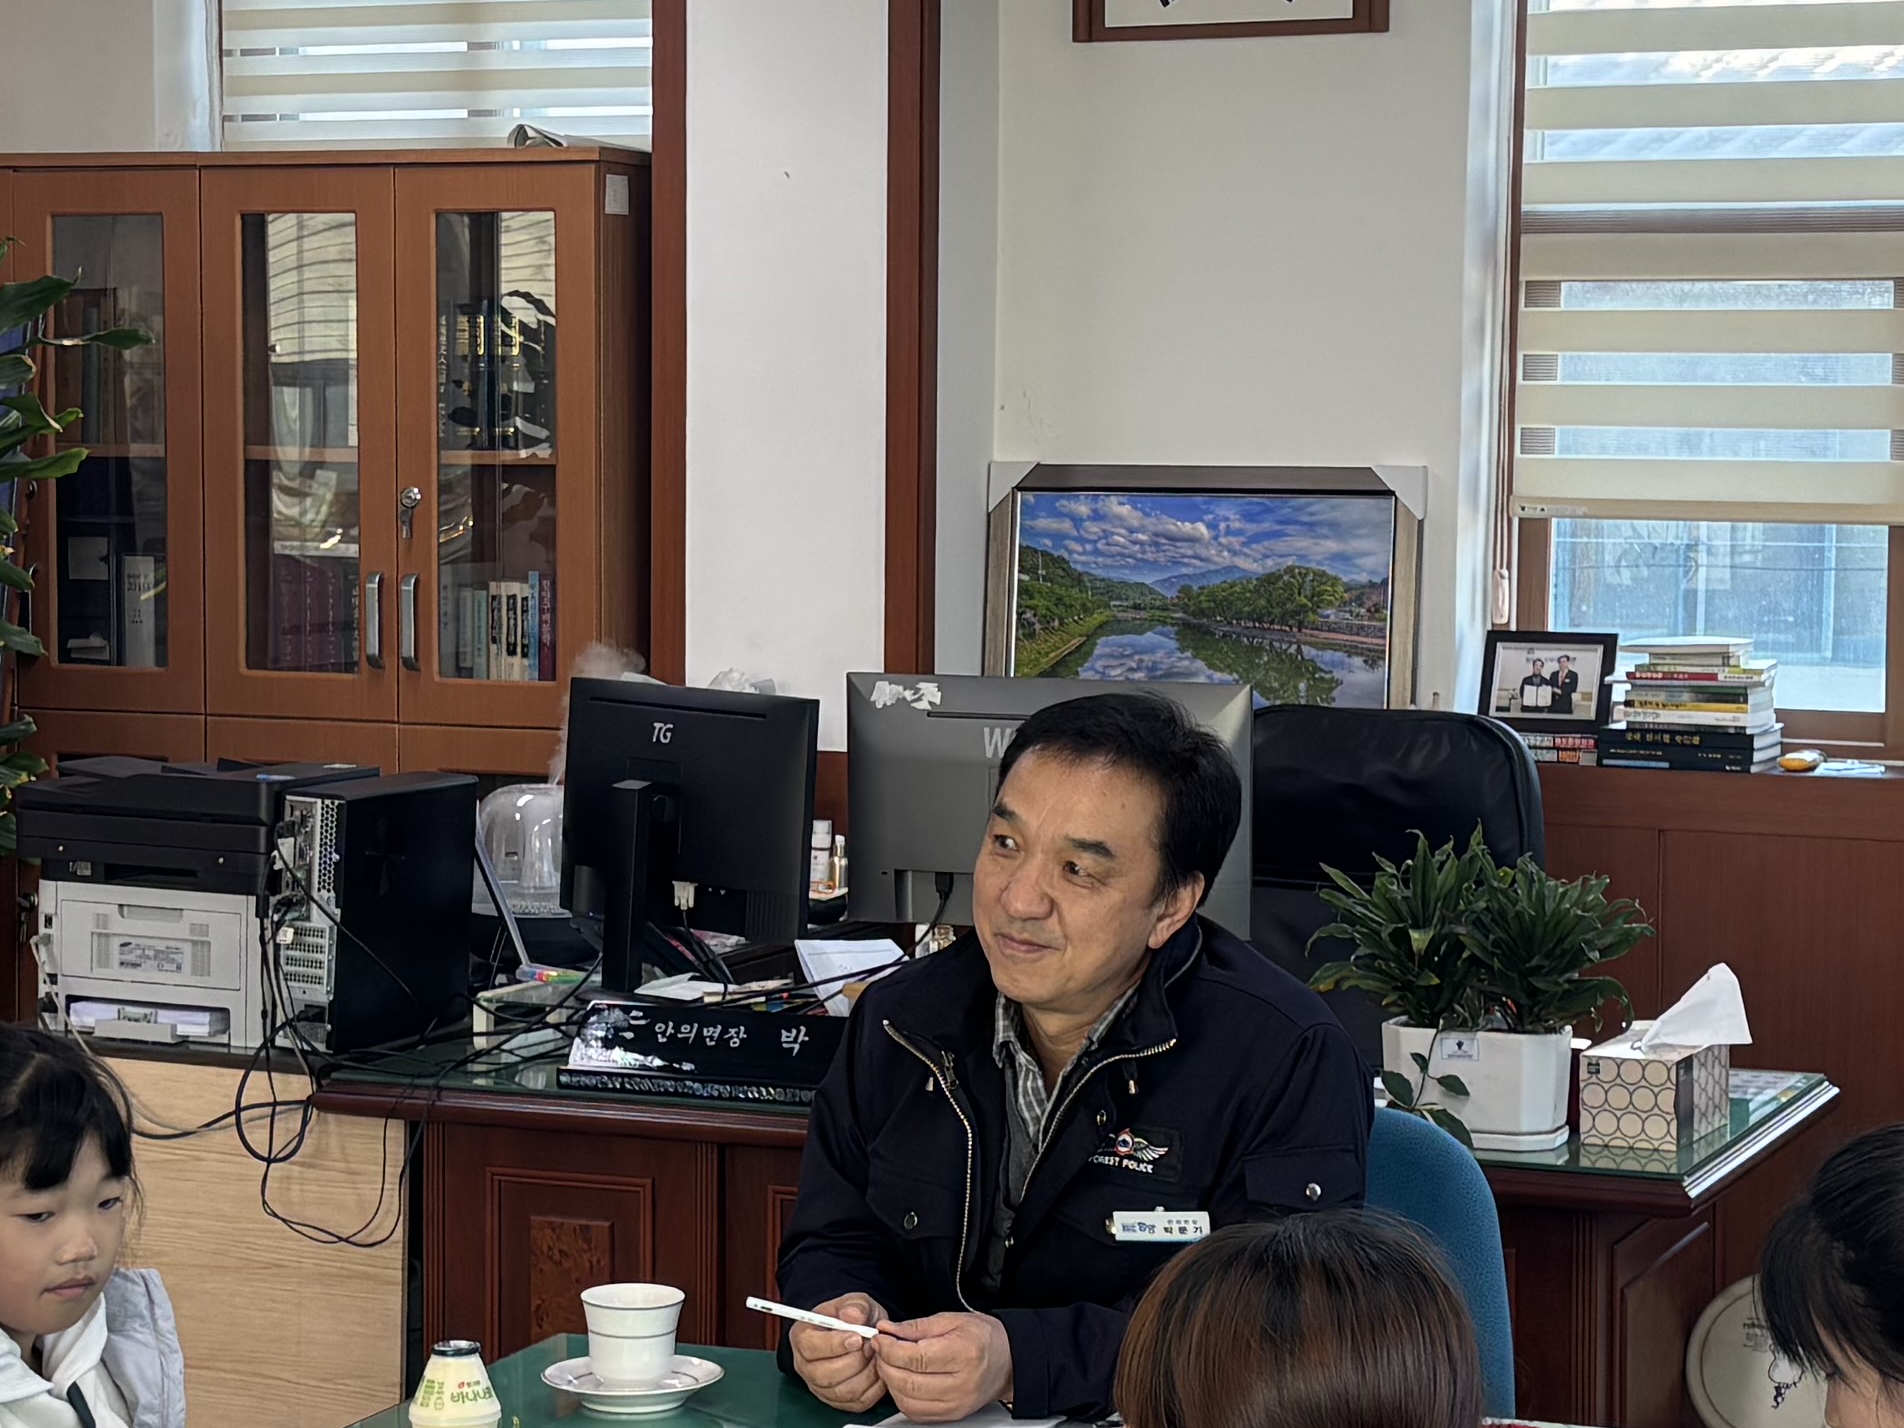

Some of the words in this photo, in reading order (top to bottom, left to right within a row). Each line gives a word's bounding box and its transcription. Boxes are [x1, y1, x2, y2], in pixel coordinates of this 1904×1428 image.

[652, 722, 673, 744] TG
[654, 1020, 748, 1048] 안의면장
[780, 1025, 810, 1057] 박
[1122, 1158, 1154, 1174] POLICE
